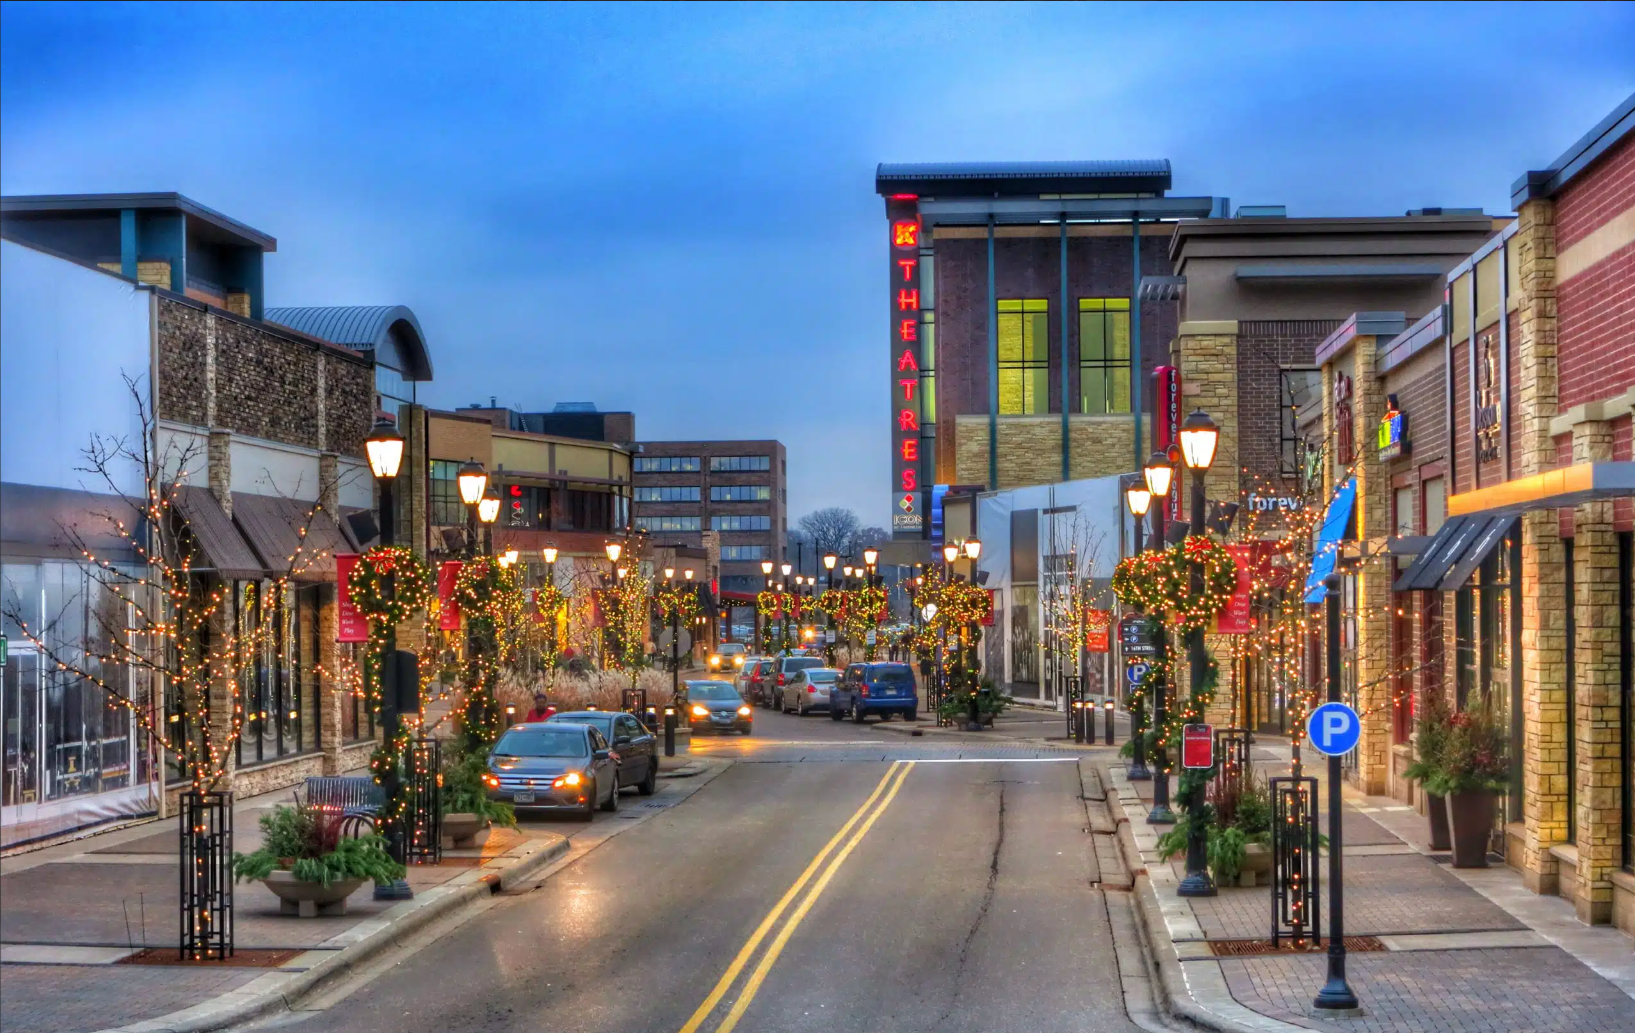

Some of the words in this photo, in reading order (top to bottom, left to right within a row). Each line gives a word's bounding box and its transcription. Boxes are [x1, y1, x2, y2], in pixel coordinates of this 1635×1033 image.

[897, 258, 919, 491] THEATRES
[1247, 492, 1302, 511] forev
[893, 514, 923, 525] ICON
[1133, 664, 1146, 681] P
[1322, 711, 1350, 747] P
